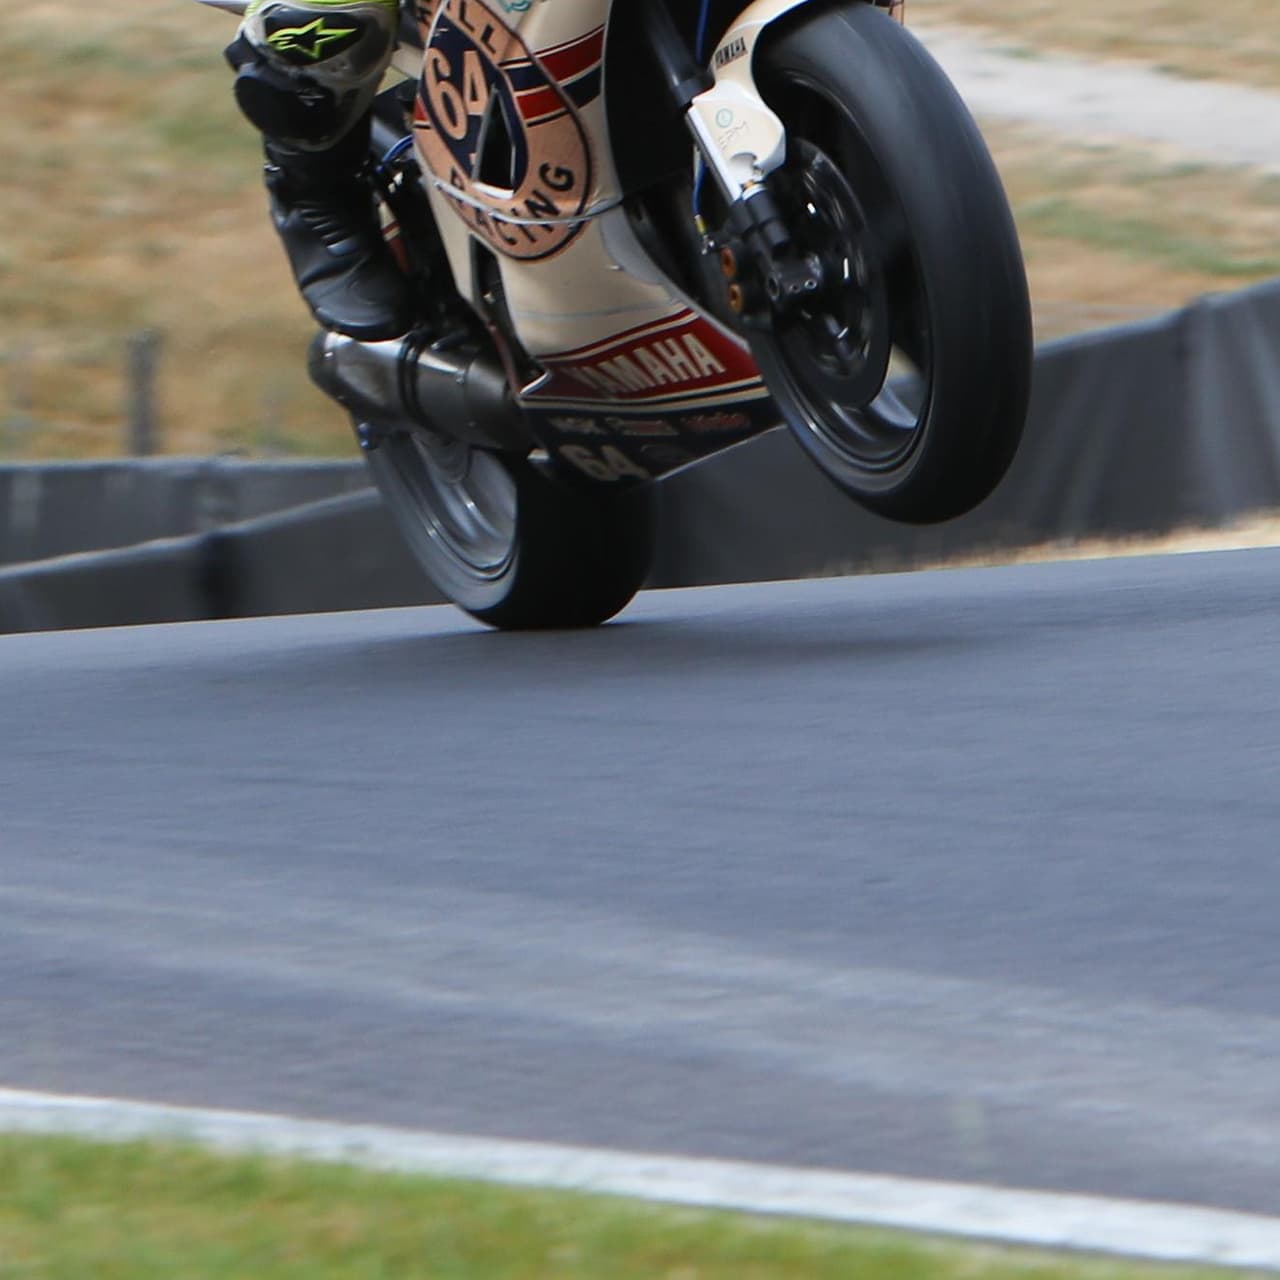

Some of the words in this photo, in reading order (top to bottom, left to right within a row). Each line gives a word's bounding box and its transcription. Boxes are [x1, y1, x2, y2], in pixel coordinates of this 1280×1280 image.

[424, 47, 489, 141] 64
[562, 332, 727, 394] YAMAHA
[558, 444, 652, 482] 64
